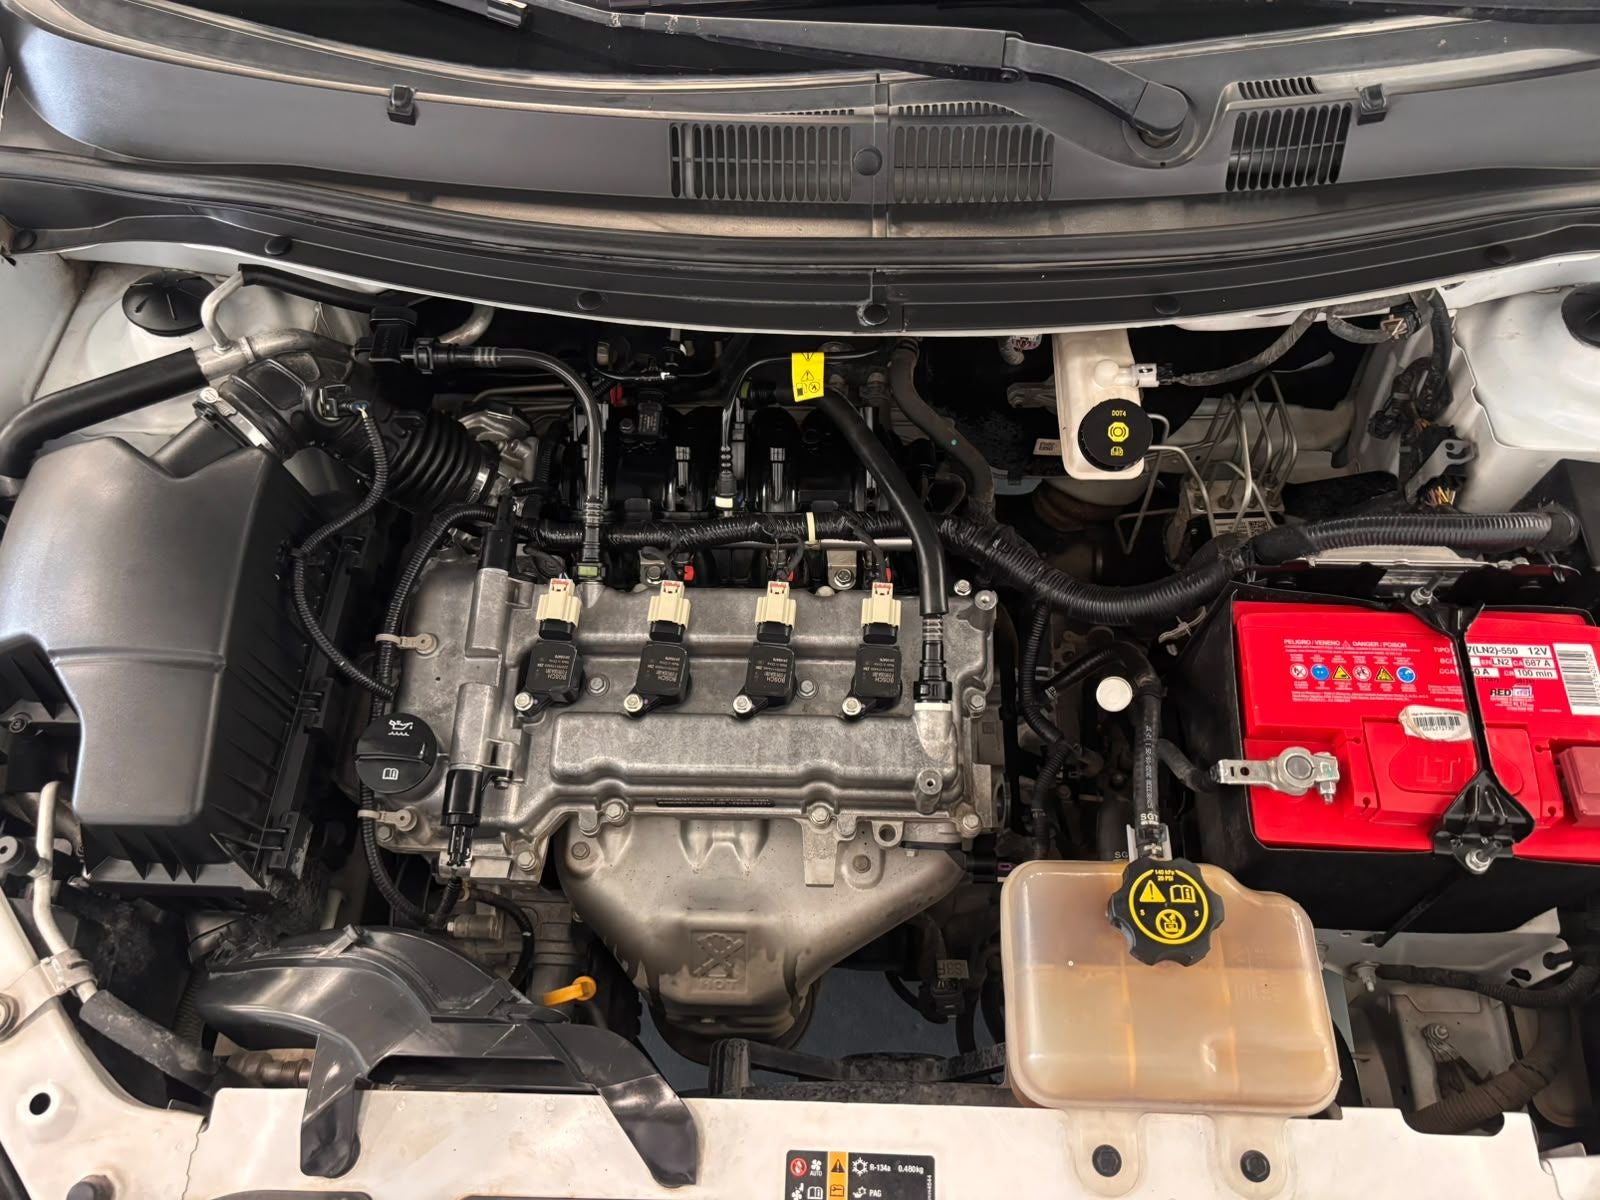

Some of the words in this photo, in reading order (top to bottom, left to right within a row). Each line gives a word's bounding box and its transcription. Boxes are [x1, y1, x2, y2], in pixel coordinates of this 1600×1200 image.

[1467, 645, 1519, 655] 7(LN2)-550
[1528, 647, 1548, 655] 12V
[1492, 658, 1510, 666] LN2
[1114, 851, 1129, 859] SG
[869, 1163, 891, 1172] R-134a
[869, 1189, 882, 1198] PAG
